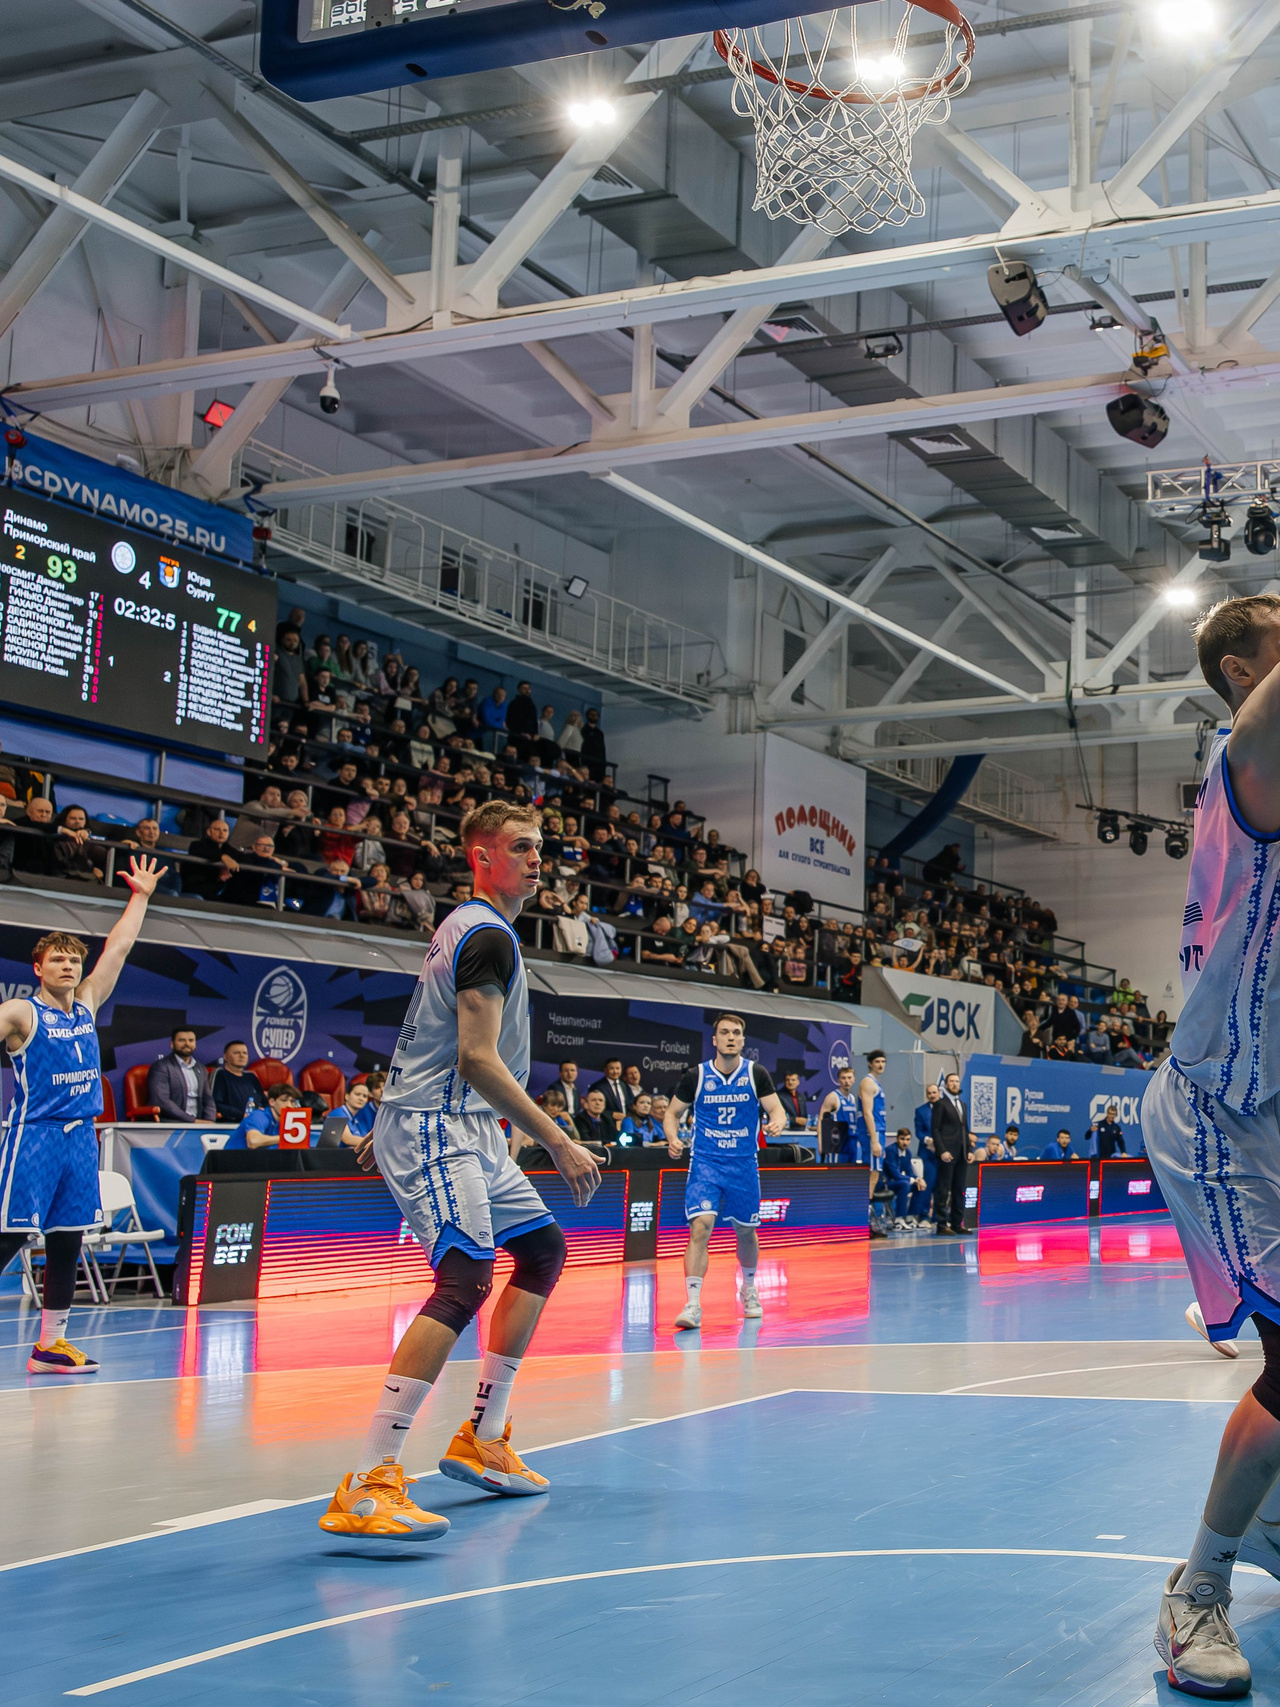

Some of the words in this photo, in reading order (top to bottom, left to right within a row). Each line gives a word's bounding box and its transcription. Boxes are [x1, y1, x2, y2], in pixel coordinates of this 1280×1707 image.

[4, 508, 48, 532] Динамо
[4, 522, 70, 555] Приморский
[72, 547, 96, 563] край
[15, 544, 26, 560] 2
[47, 555, 77, 583] 93
[9, 576, 42, 593] ЕРШОВ
[138, 570, 151, 590] 4
[187, 570, 211, 588] Югра
[9, 585, 44, 603] ГИНЬКО
[90, 591, 99, 601] 17
[185, 583, 216, 603] Сургут
[8, 595, 49, 614] ЗАХАРОВ
[7, 605, 66, 629] ДЕСЯТНИКОВ
[88, 610, 98, 620] 10
[113, 597, 176, 631] 02:32:5
[216, 607, 242, 633] 77
[6, 614, 48, 634] САДИКОВ
[247, 619, 257, 633] 4
[5, 624, 48, 643] ДЕНИСОВ
[85, 637, 92, 646] 0
[4, 643, 40, 660] КРОУЛИ
[107, 655, 114, 667] 1
[83, 673, 89, 682] 0
[163, 670, 172, 683] 2
[81, 691, 88, 701] 0
[82, 682, 89, 692] 0
[774, 804, 856, 857] ПОМОЩНИК
[809, 837, 825, 855] ВСЕ
[549, 1012, 602, 1029] Чемпионат
[936, 997, 981, 1041] ВСК
[261, 1027, 295, 1050] СУПЕР
[547, 1030, 584, 1046] России
[660, 1040, 690, 1054] Fonbet
[74, 1040, 83, 1064] 1
[831, 1056, 849, 1069] РФБ
[70, 1081, 92, 1097] КРАЙ
[703, 1093, 750, 1104] ДИНАМО
[718, 1106, 737, 1125] 22
[283, 1111, 307, 1144] 5
[718, 1138, 737, 1148] КРАЙ
[214, 1222, 254, 1244] FON
[213, 1243, 252, 1265] BET
